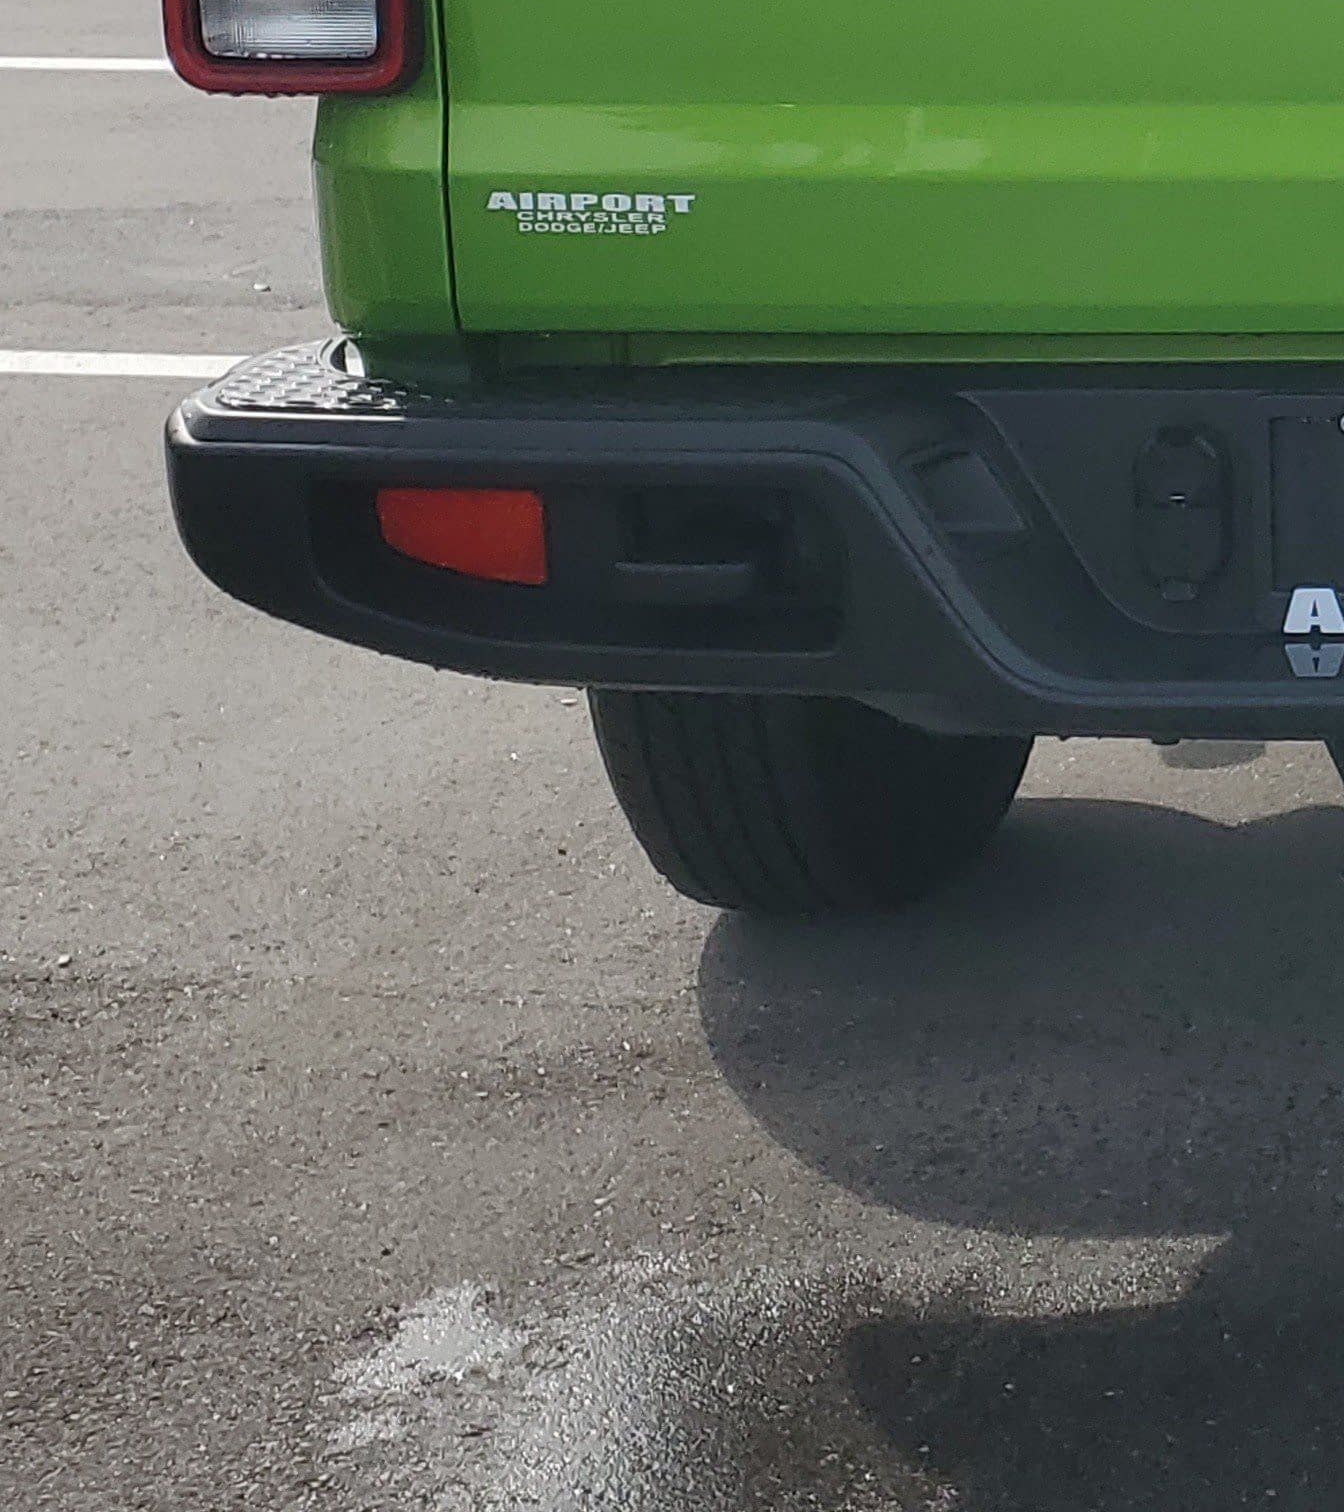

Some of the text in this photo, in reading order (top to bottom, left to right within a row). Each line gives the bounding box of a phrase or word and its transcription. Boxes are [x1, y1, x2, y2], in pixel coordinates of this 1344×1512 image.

[486, 191, 696, 213] AIRPORT
[516, 211, 666, 224] CHRYSLER
[518, 222, 667, 235] DODGE/JEEP
